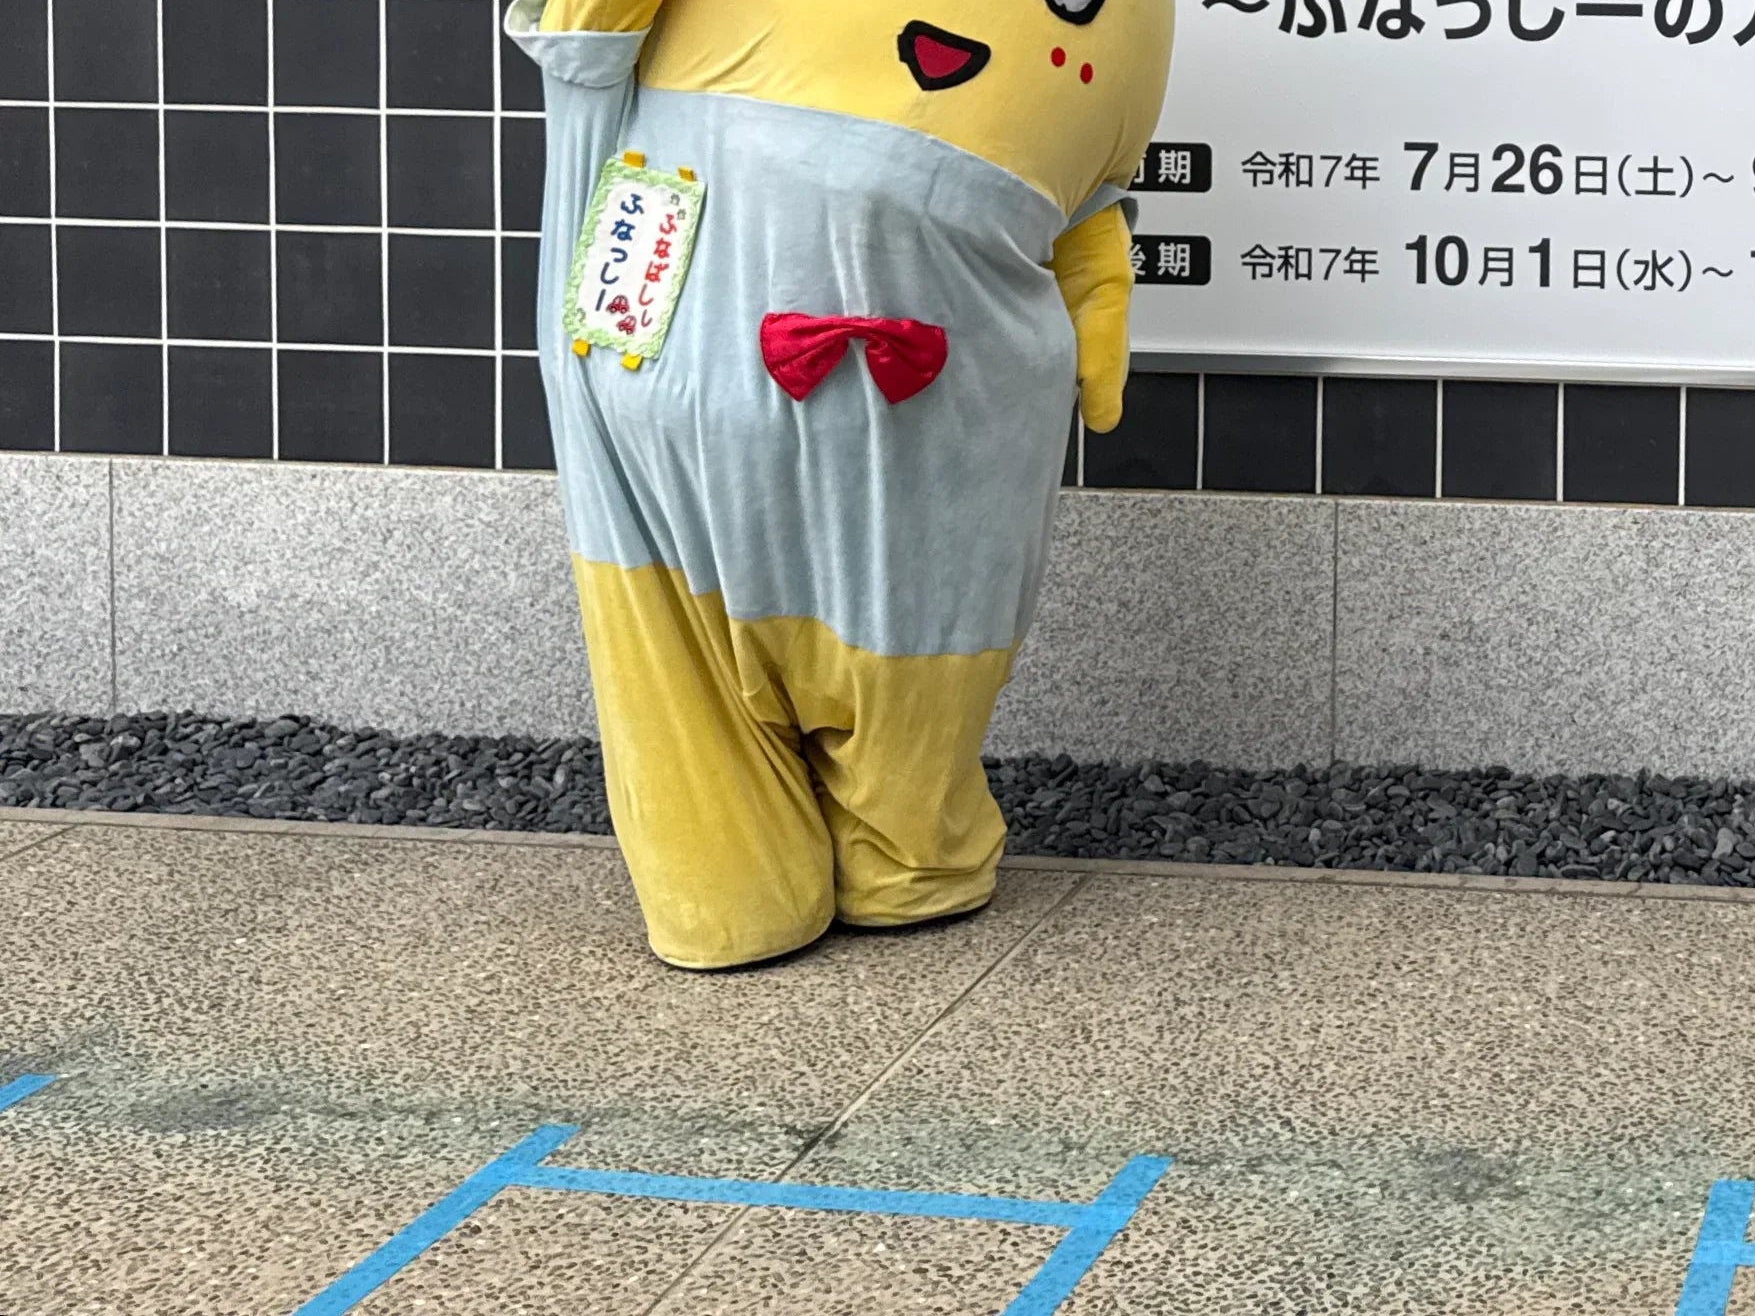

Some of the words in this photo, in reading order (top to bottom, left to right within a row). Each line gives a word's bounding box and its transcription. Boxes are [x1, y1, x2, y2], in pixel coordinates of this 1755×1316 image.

[1134, 149, 1192, 185] 期
[596, 193, 645, 312] ふなっしー
